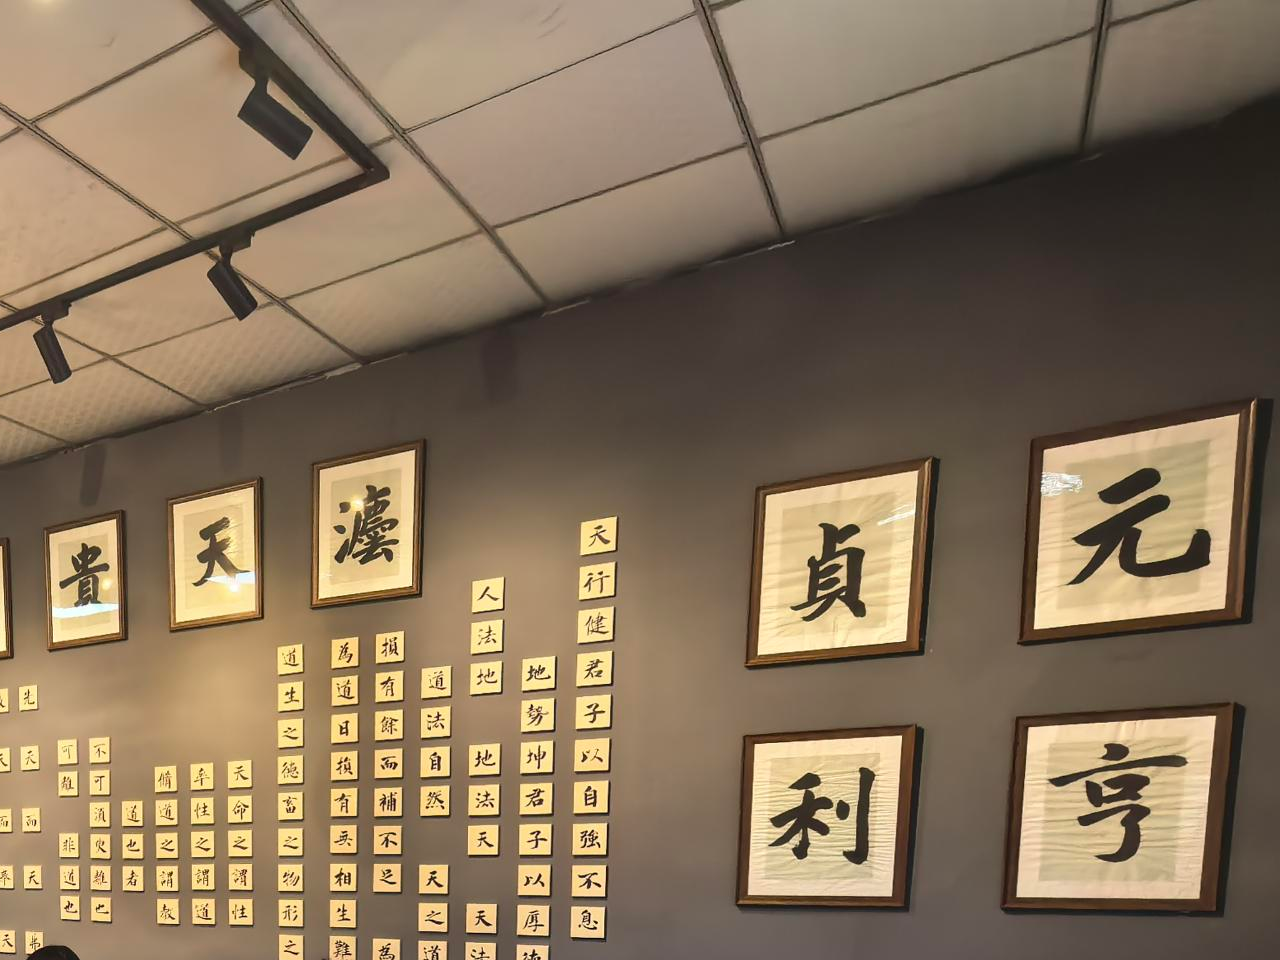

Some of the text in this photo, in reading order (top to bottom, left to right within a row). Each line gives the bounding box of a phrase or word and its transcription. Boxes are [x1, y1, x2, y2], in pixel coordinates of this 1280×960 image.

[59, 542, 111, 608] 貴
[192, 515, 252, 587] 天
[790, 522, 867, 622] 貞
[1065, 467, 1212, 585] 元
[476, 586, 501, 685] 人法地
[426, 673, 447, 809] 道法自然
[125, 804, 141, 886] 道也者
[193, 767, 213, 920] 率性之謂道
[231, 765, 249, 920] 天命之謂性
[474, 749, 497, 848] 地法天
[767, 767, 876, 864] 利
[1049, 743, 1187, 863] 亨
